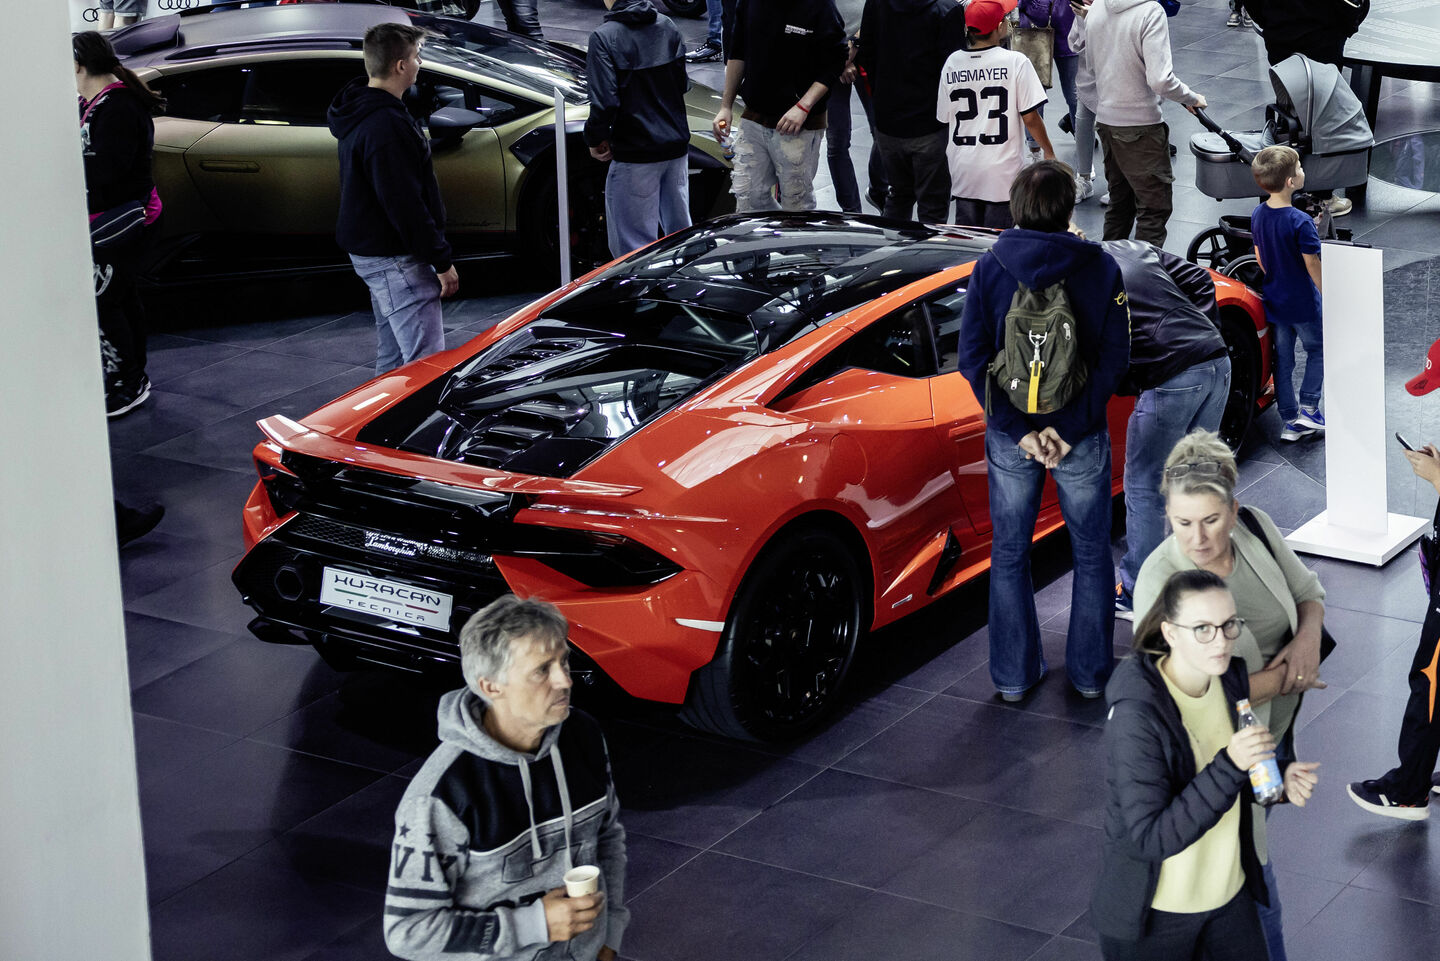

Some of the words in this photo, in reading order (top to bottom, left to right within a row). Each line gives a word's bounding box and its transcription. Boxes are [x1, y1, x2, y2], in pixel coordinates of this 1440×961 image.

[946, 67, 1008, 84] LINSMAYER
[949, 86, 1009, 146] 23
[365, 536, 417, 556] Lamborghini
[346, 598, 425, 621] TECNICA
